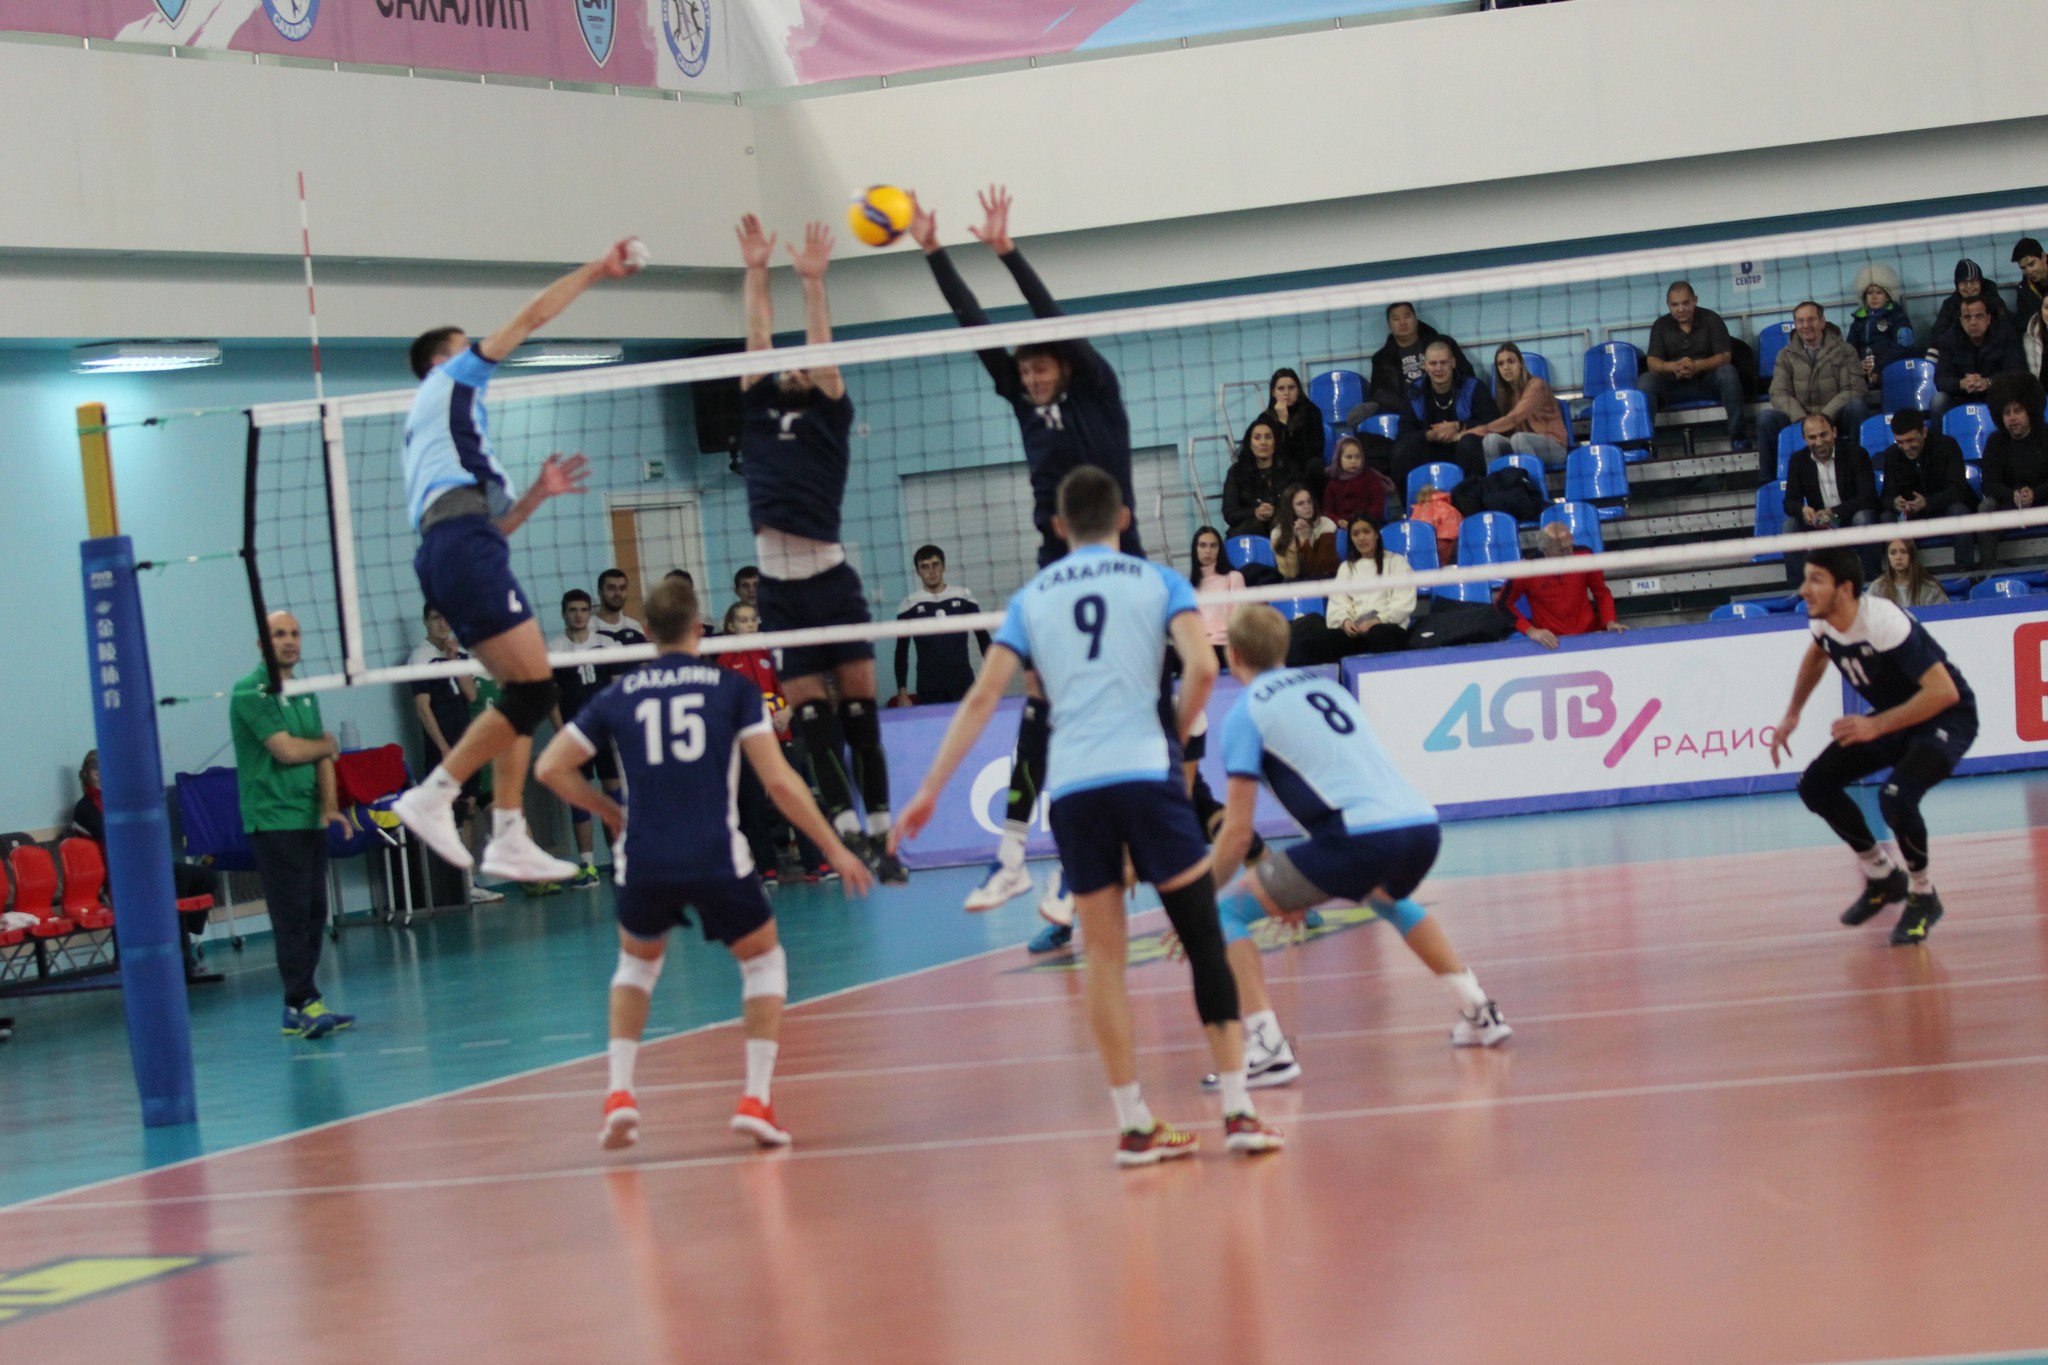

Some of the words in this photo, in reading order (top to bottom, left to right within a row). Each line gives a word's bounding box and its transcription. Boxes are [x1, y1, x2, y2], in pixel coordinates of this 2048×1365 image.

[1735, 274, 1762, 286] СЕКТОР
[1038, 561, 1143, 592] САХАЛИН
[1073, 594, 1107, 661] 9
[623, 665, 721, 694] САХАЛИН
[1841, 656, 1871, 686] 11
[635, 692, 707, 766] 15
[1306, 692, 1355, 735] 8
[1654, 725, 1779, 758] РАДИО
